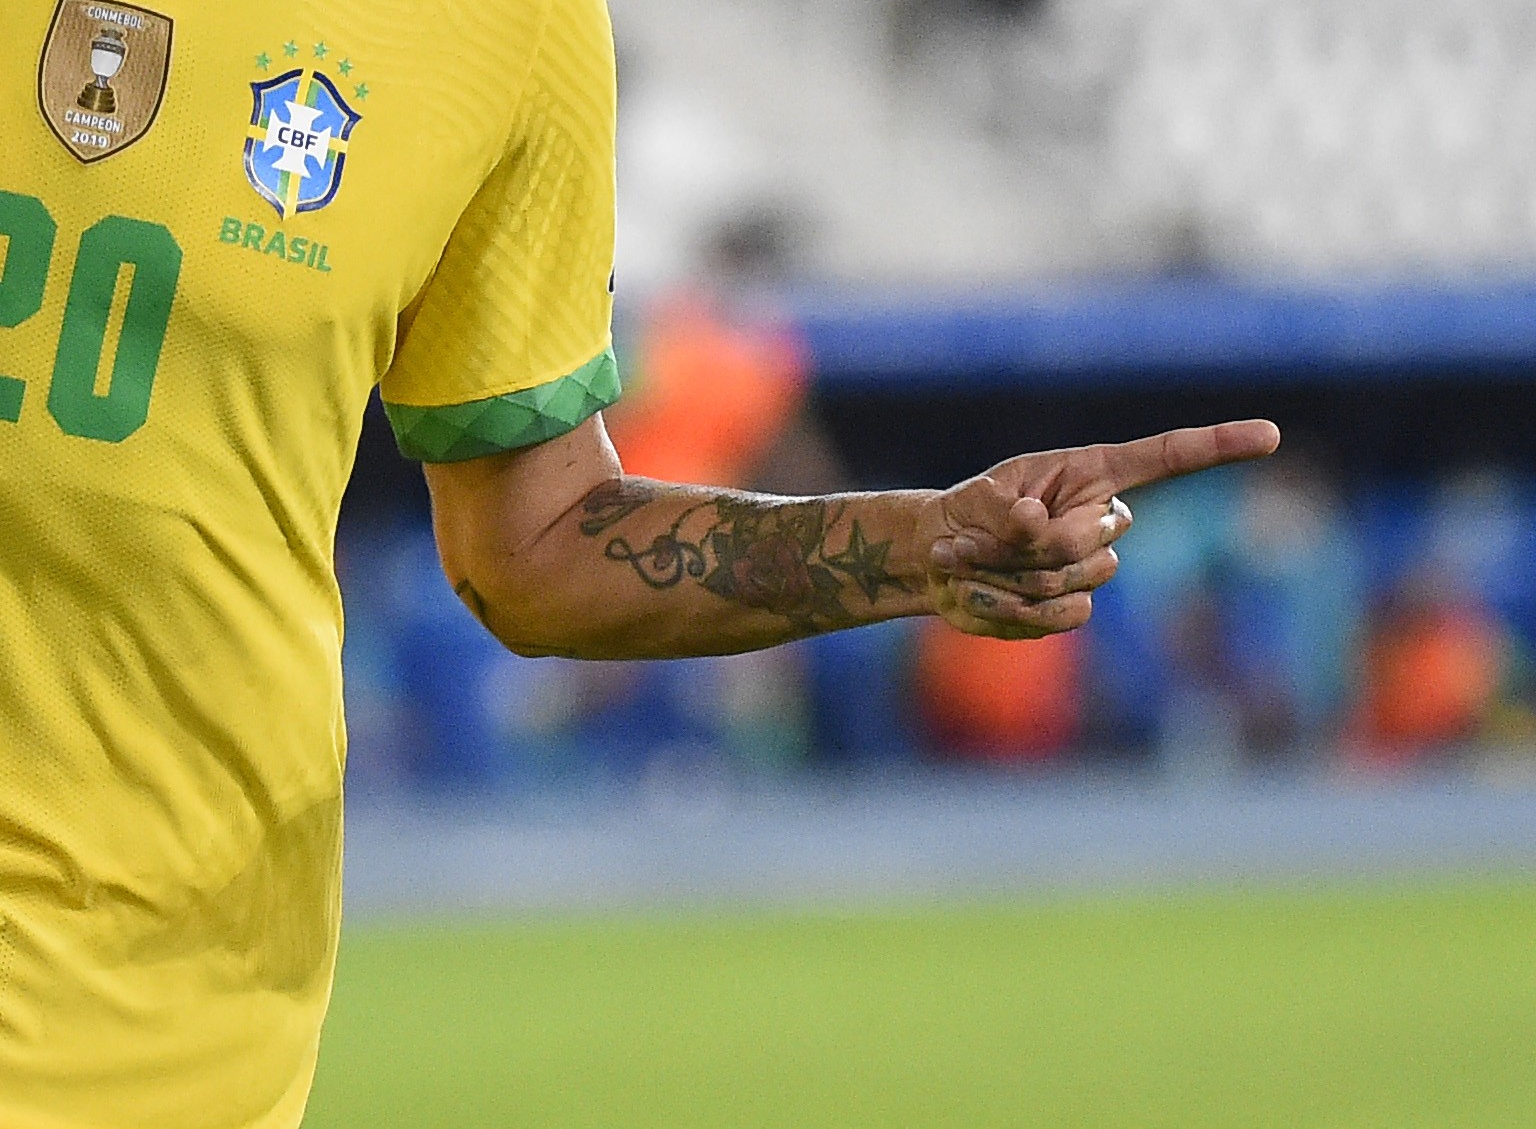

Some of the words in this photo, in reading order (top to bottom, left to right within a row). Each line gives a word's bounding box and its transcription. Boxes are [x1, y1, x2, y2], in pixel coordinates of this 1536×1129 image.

[87, 6, 144, 29] CONMEBOL
[71, 131, 109, 148] 2019
[277, 126, 318, 150] CBF
[219, 216, 332, 272] BRASIL
